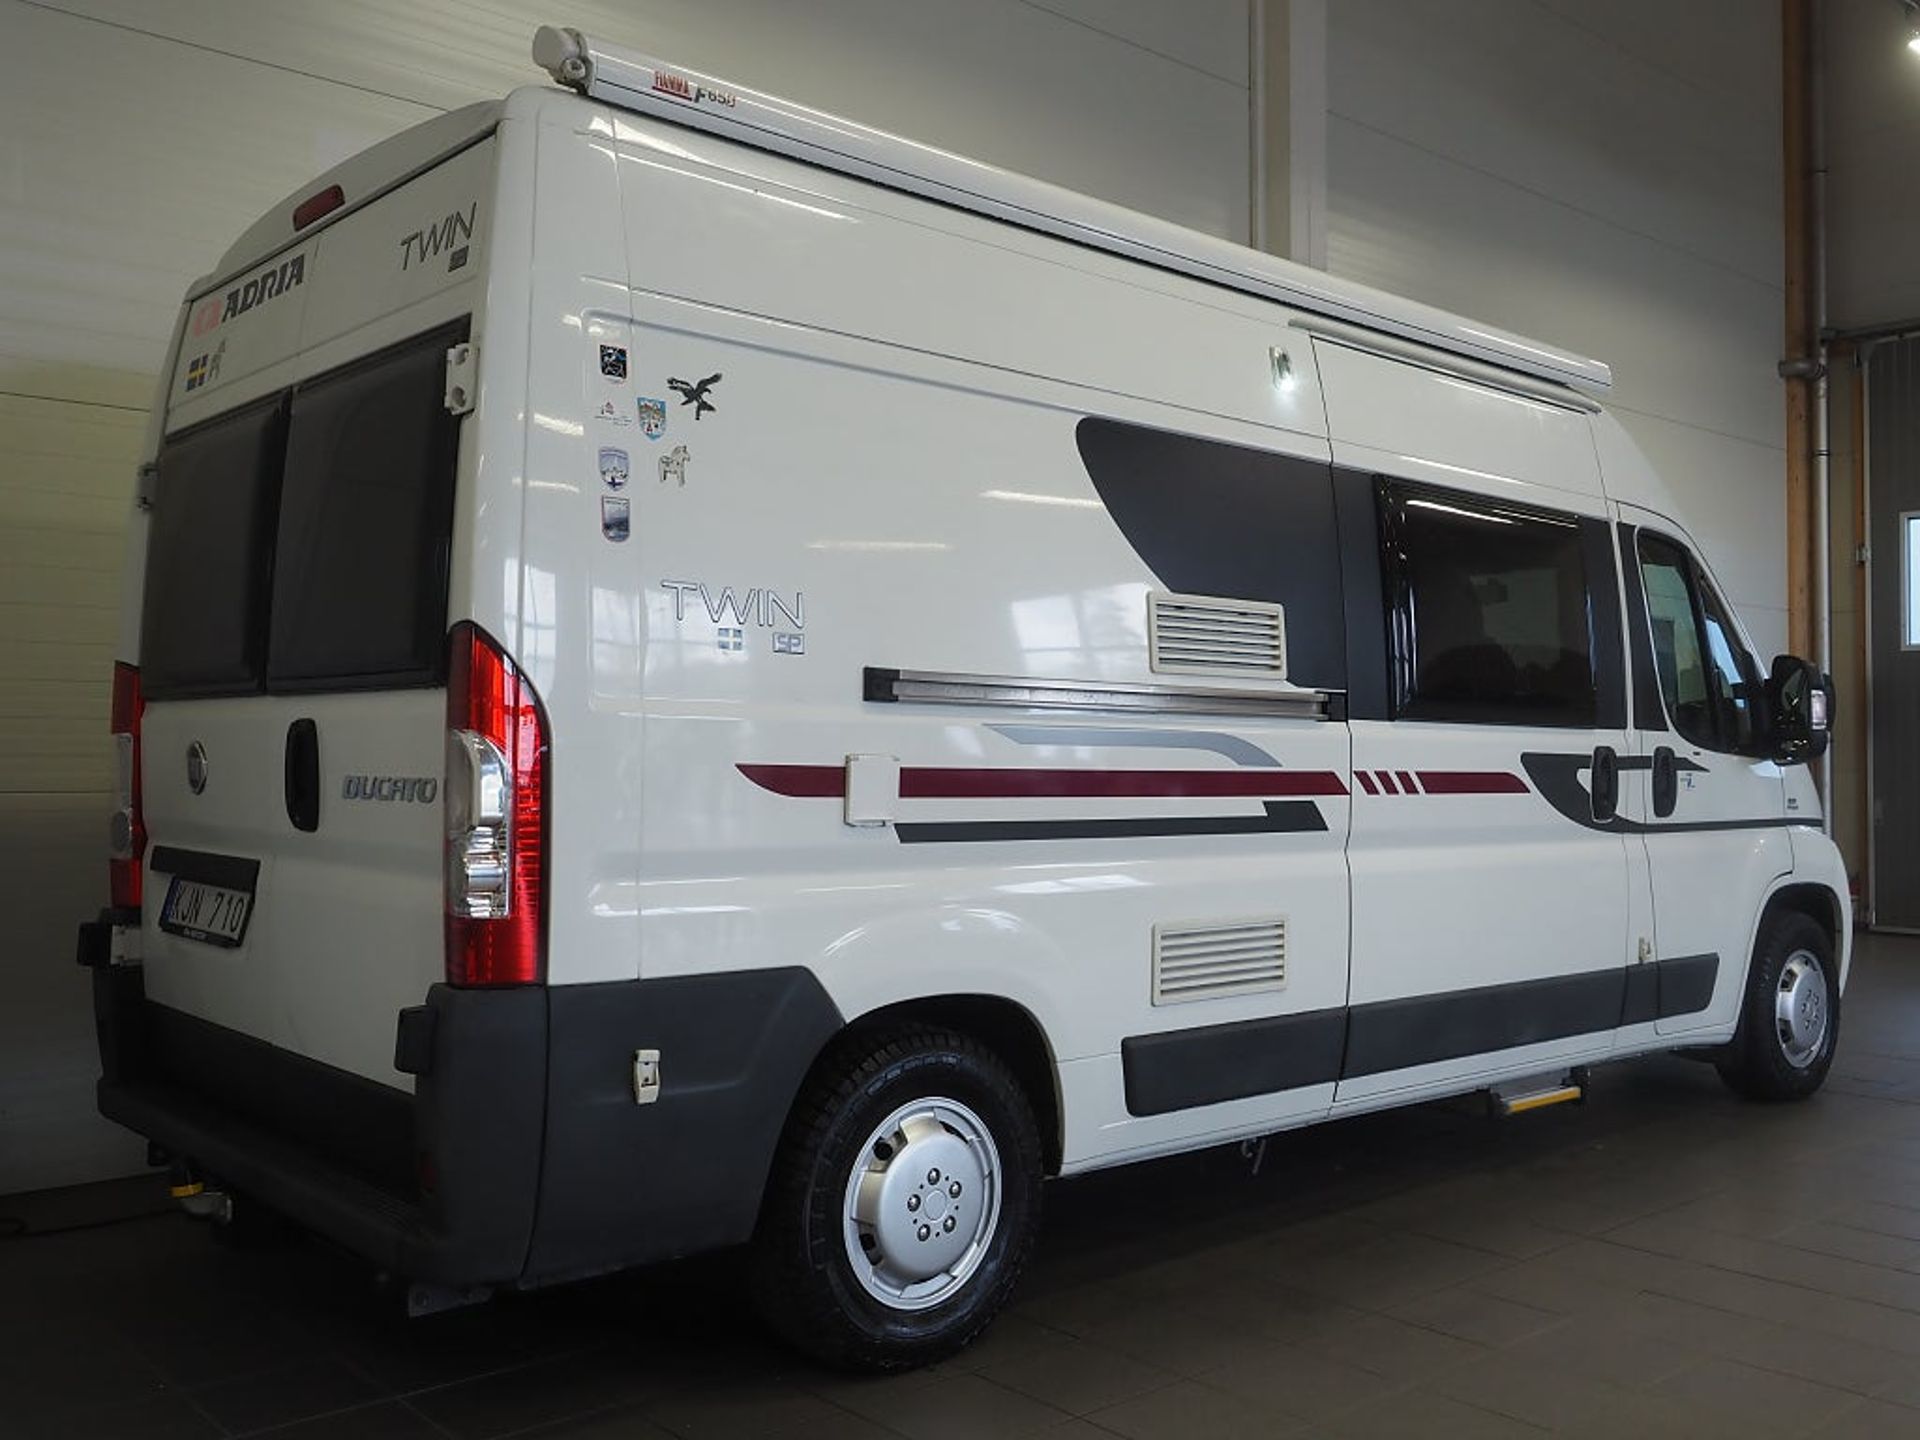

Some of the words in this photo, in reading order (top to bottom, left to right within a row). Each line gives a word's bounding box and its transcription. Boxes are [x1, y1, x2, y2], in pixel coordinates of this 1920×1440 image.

[400, 201, 477, 271] TWIN
[221, 253, 305, 323] ADRIA
[660, 579, 804, 629] TWIN
[342, 775, 438, 804] DUCATO
[208, 891, 245, 933] 710
